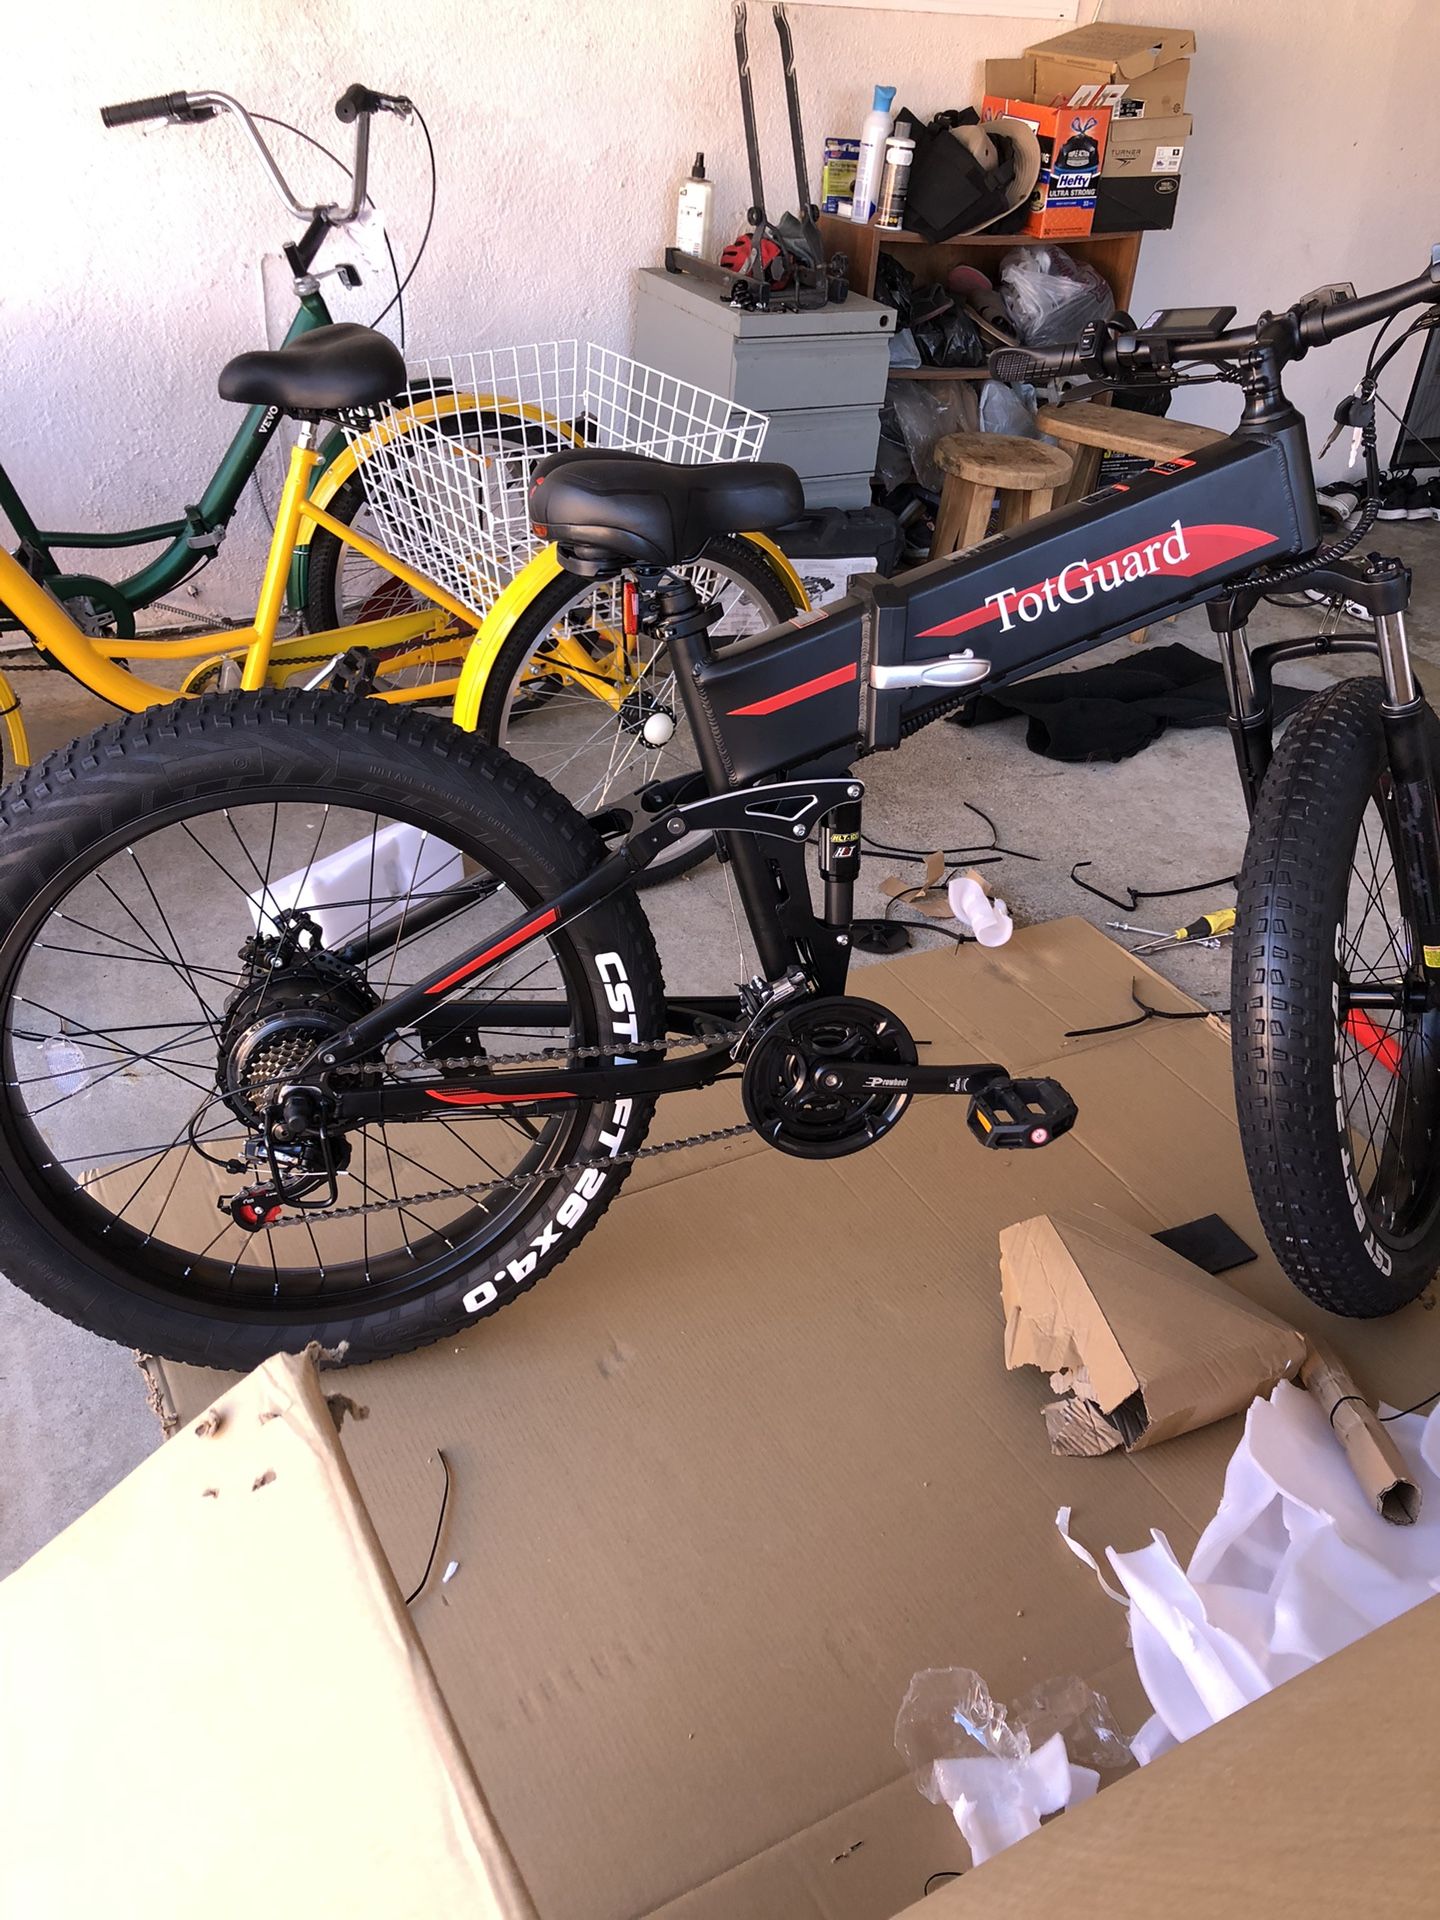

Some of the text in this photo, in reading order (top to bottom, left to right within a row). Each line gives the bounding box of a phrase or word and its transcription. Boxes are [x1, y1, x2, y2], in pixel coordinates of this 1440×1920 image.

[1049, 188, 1096, 197] ULTRA STRONG
[1058, 174, 1090, 188] Hefty
[258, 405, 279, 433] VEVO
[984, 519, 1191, 634] TotGuard
[594, 951, 639, 1046] CST
[1363, 1232, 1393, 1278] CST
